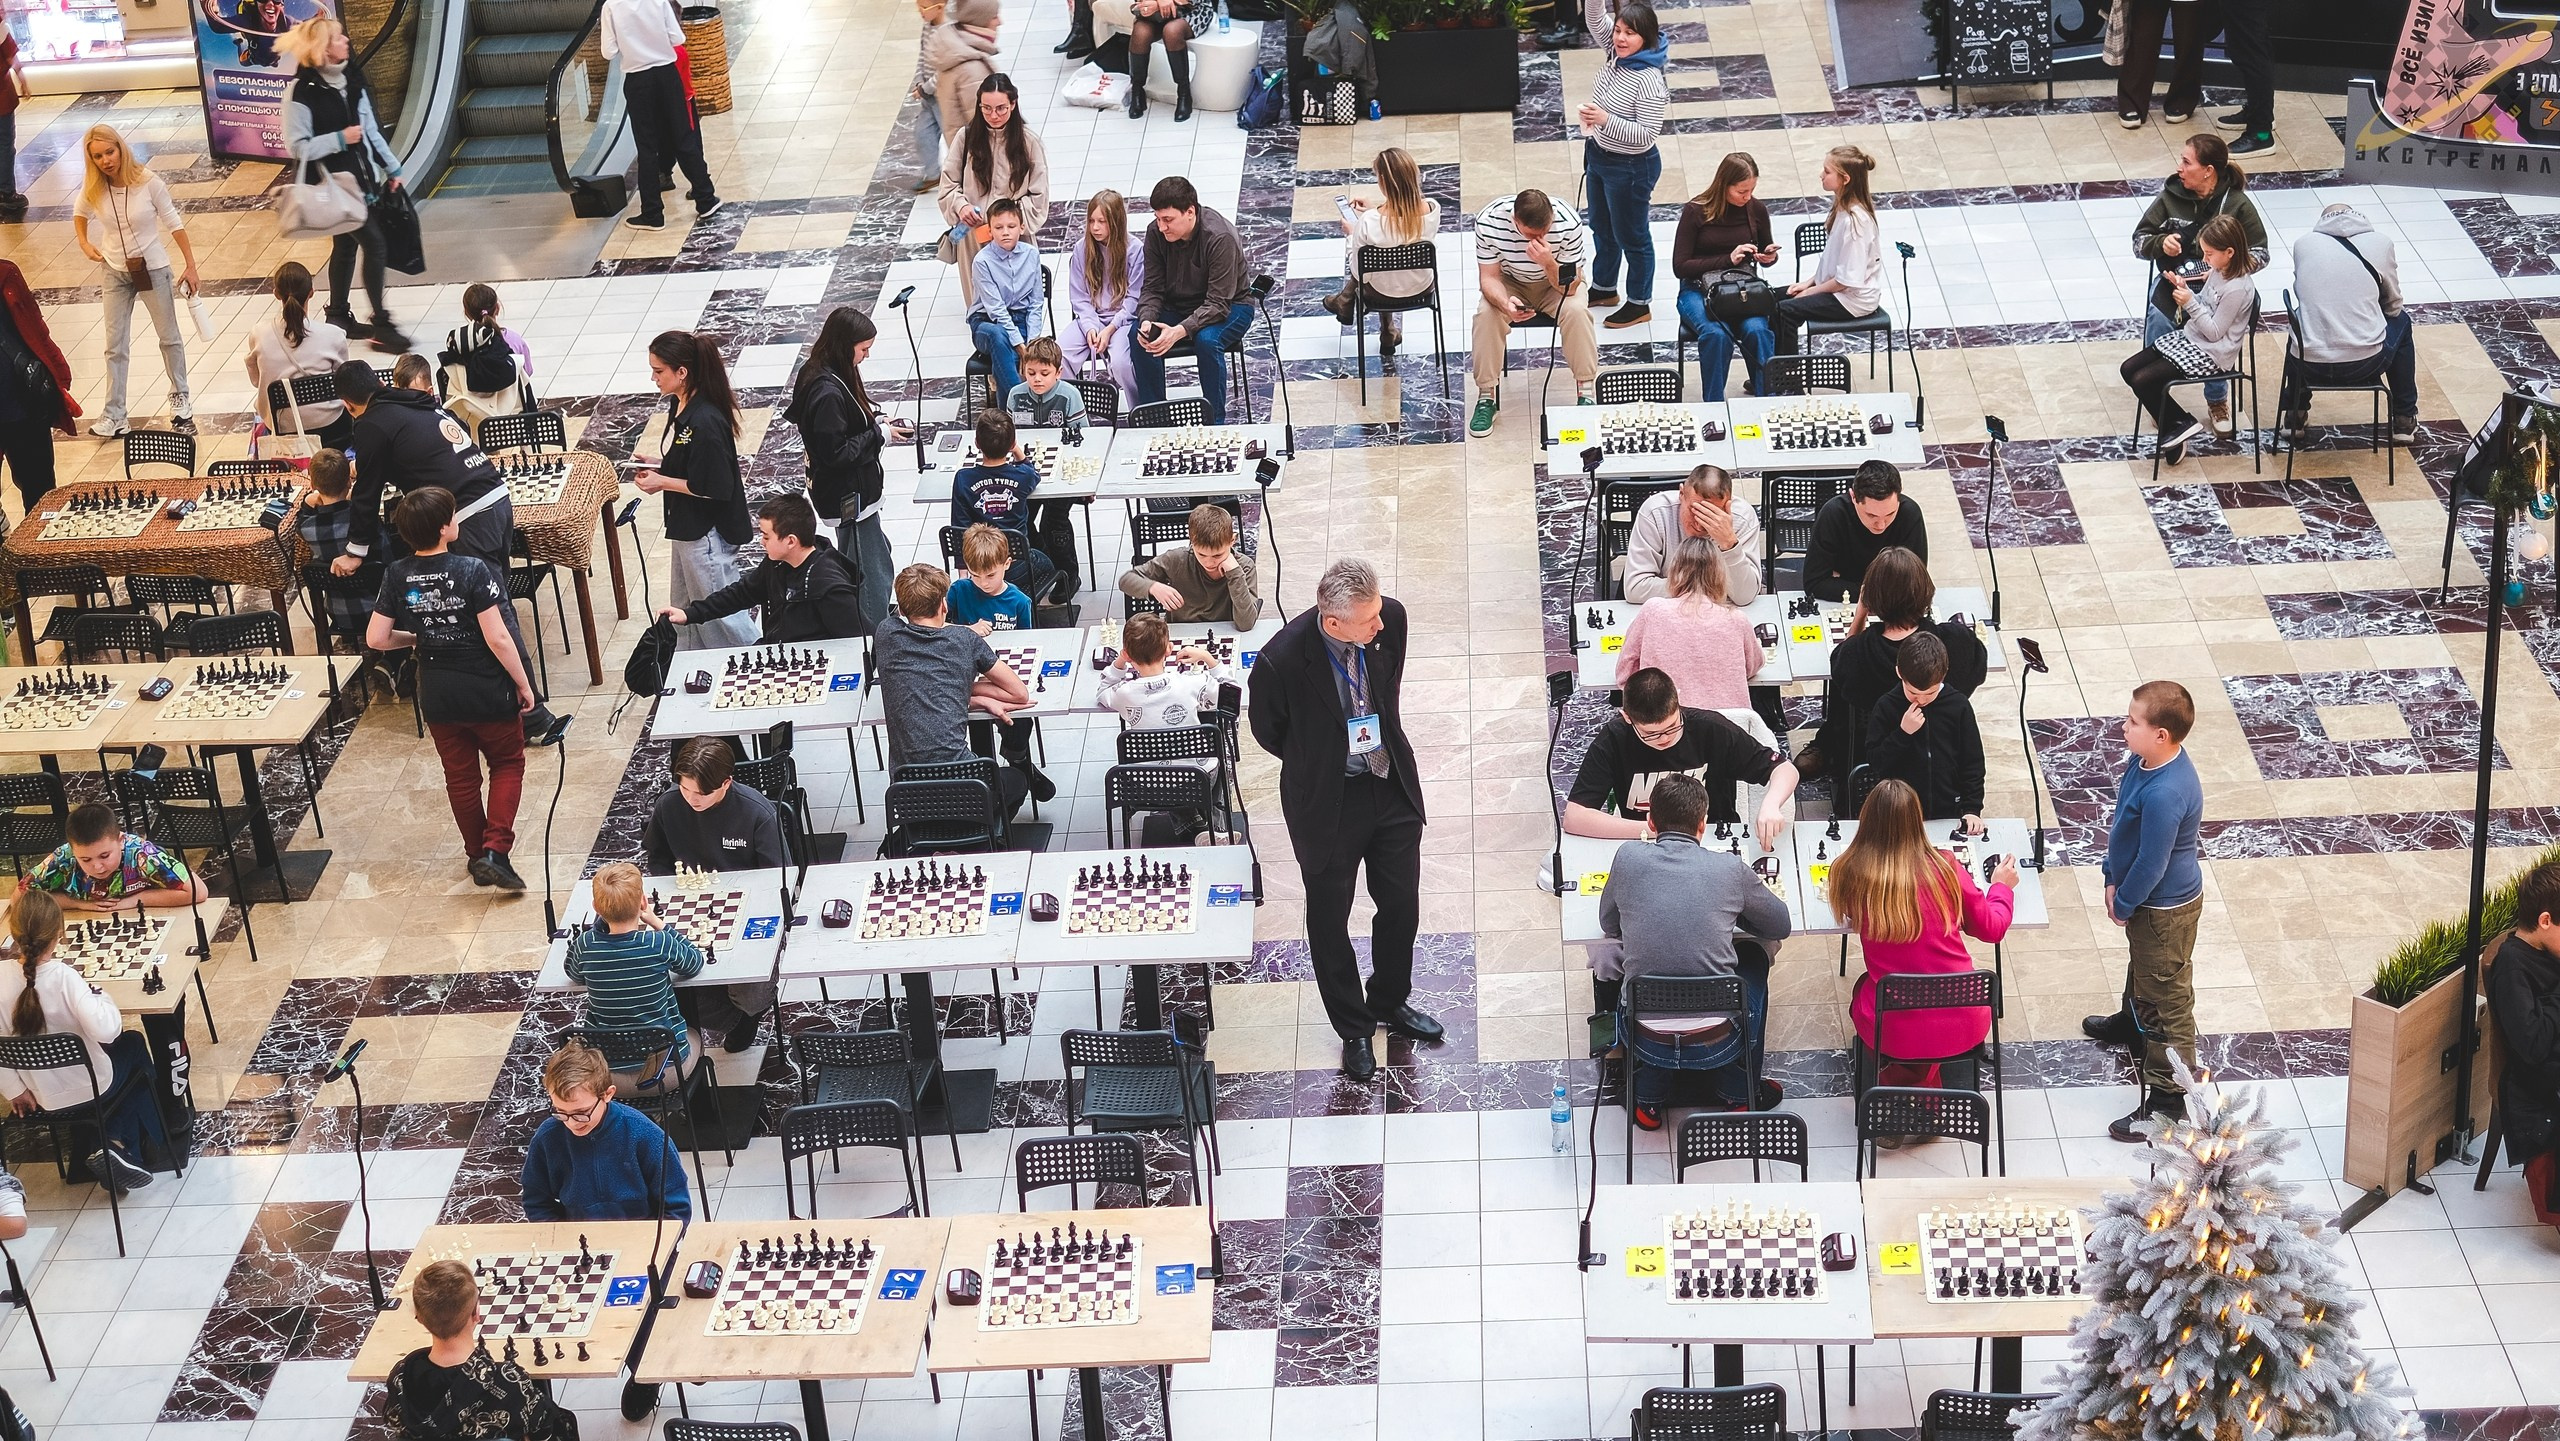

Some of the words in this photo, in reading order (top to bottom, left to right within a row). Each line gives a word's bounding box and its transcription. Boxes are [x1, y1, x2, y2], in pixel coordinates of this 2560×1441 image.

[2400, 47, 2423, 86] ВСЁ
[218, 75, 286, 88] БЕЗОПАСНЫЙ
[240, 87, 247, 95] С
[249, 89, 283, 98] ПАРАШ
[217, 103, 224, 111] С
[225, 104, 272, 115] ПОМОЩЬЮ
[970, 478, 993, 492] MOTOR
[995, 478, 1019, 489] TYRES
[406, 572, 449, 583] ВОСТОК-1
[993, 613, 1008, 622] TOM
[993, 622, 1017, 630] JERRY
[1216, 886, 1235, 894] 6
[168, 1041, 189, 1097] FILA
[1640, 1248, 1655, 1256] C
[1894, 1245, 1908, 1253] C
[1163, 1269, 1186, 1277] 1
[1635, 1264, 1657, 1273] 2
[893, 1272, 917, 1283] 2
[617, 1279, 640, 1289] 3
[1166, 1284, 1181, 1293] D
[887, 1289, 903, 1298] D
[613, 1296, 629, 1305] D
